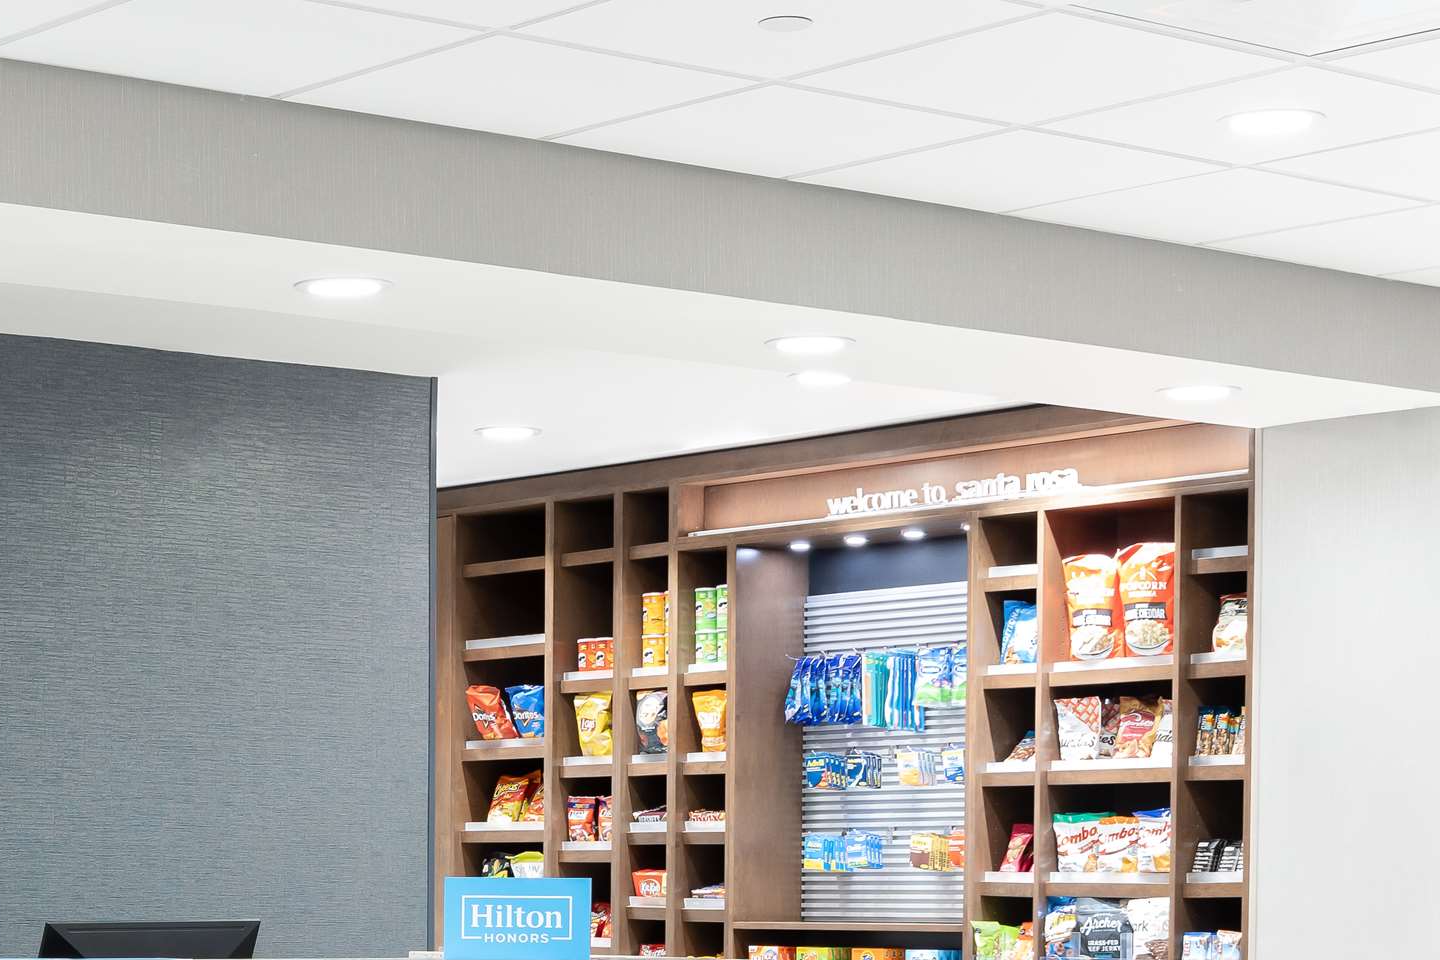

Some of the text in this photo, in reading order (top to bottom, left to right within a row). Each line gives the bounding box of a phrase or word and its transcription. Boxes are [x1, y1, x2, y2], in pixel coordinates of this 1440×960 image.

[827, 468, 1079, 514] welcome to santa rosa
[470, 904, 563, 929] Hilton
[1079, 916, 1123, 936] Archer
[484, 933, 550, 944] HONORS
